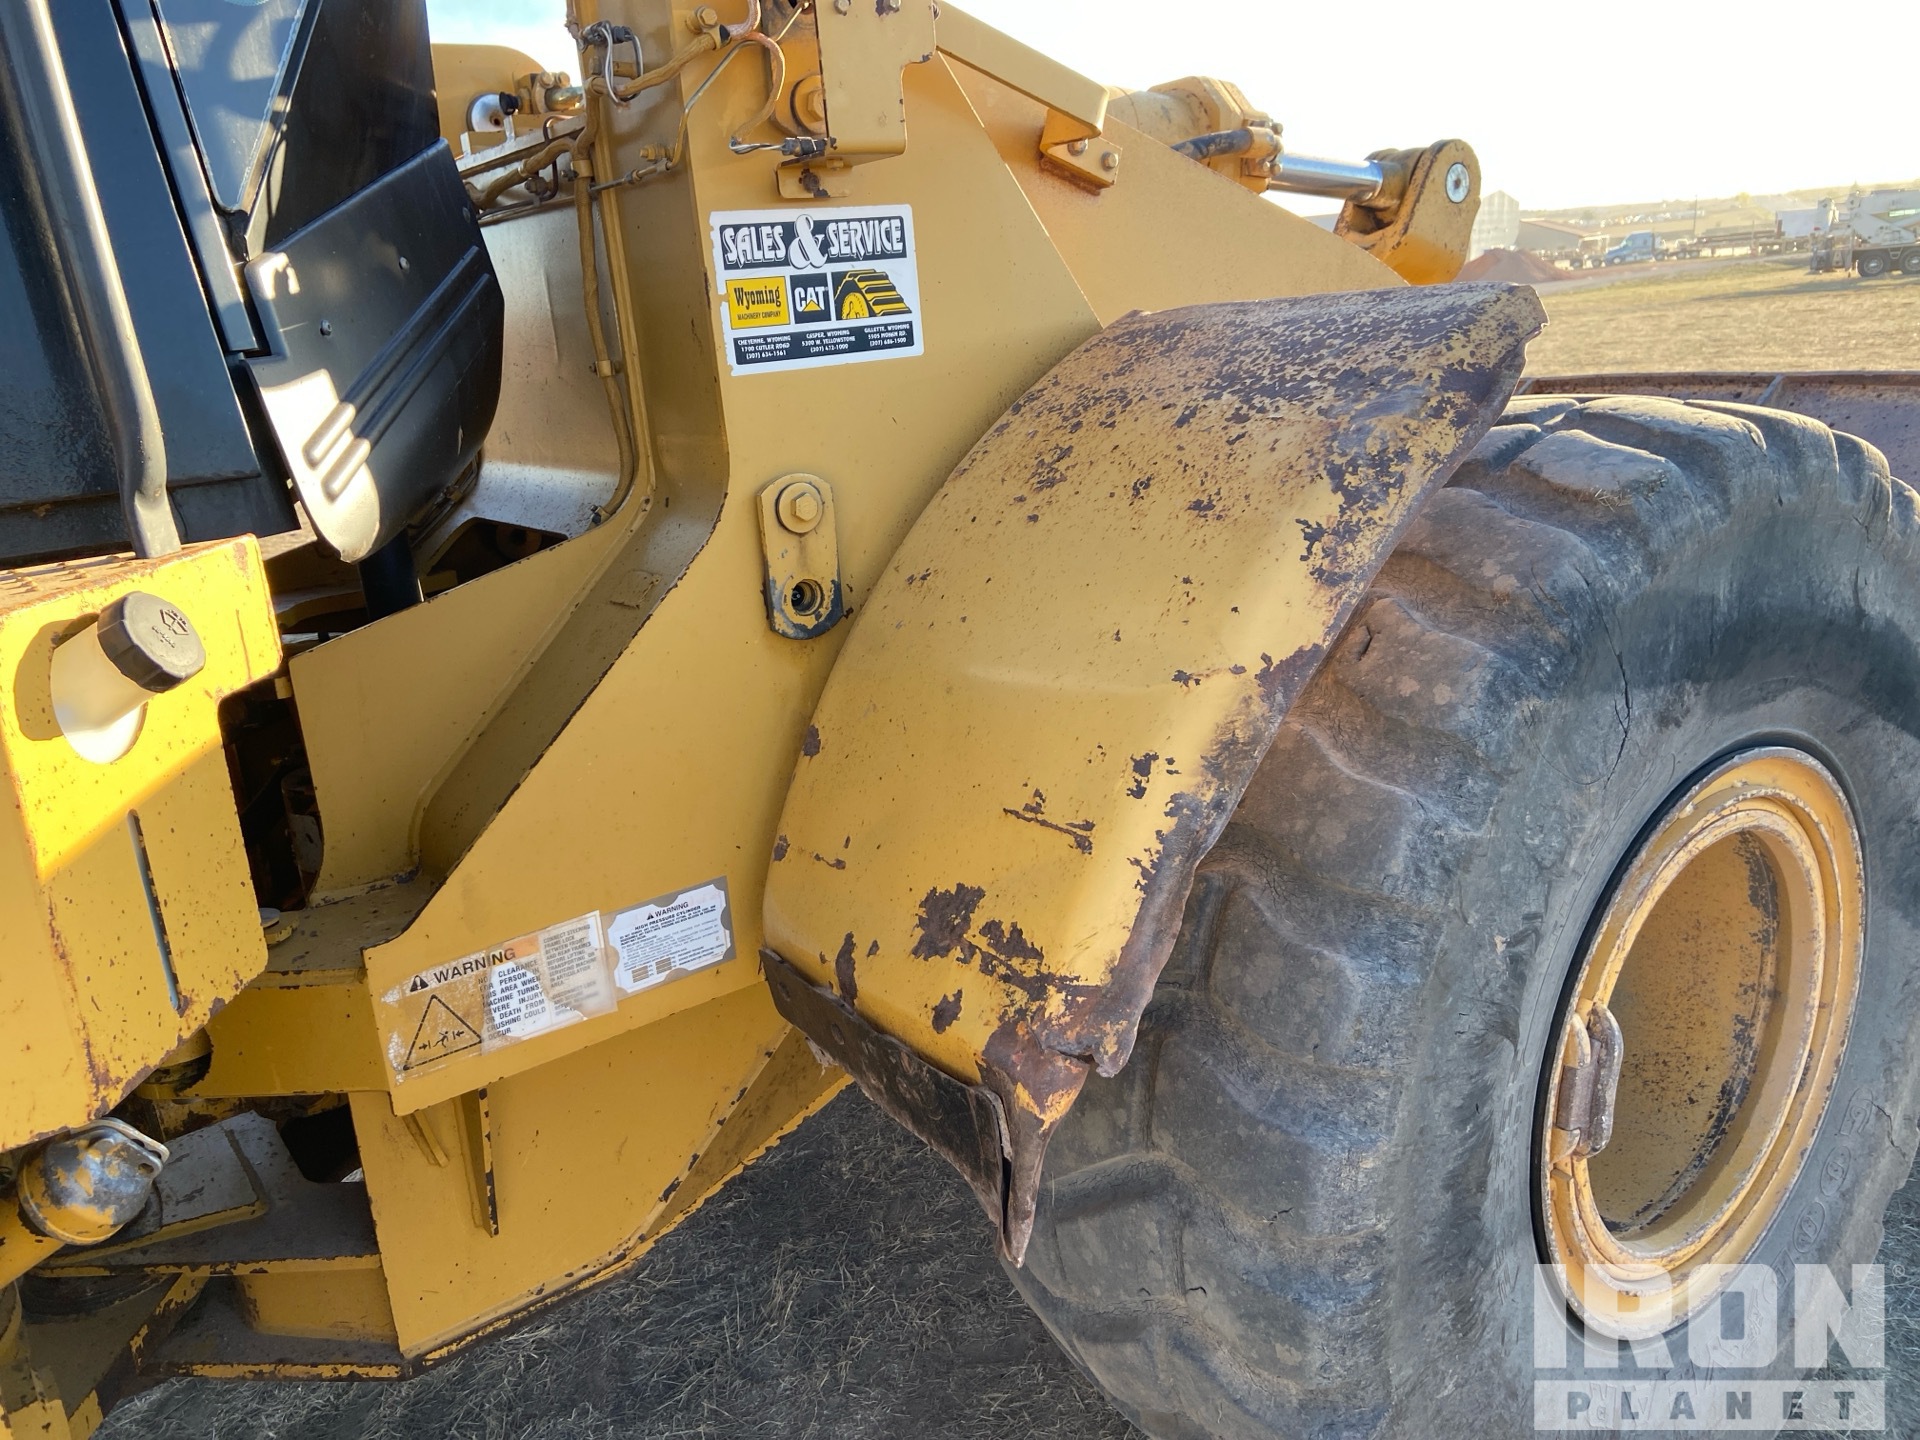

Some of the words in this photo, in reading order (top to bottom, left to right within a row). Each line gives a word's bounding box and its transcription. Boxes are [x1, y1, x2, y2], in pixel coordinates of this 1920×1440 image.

[723, 225, 786, 268] SALES
[788, 214, 828, 269] &
[827, 218, 903, 260] SERVICE
[734, 286, 781, 310] Wyoming
[794, 287, 824, 312] CAT
[767, 335, 791, 343] WYOMING
[823, 336, 855, 344] YELLOWSTONE
[649, 913, 675, 926] PRESSURE
[676, 906, 700, 916] CYLINDER
[655, 902, 688, 917] WARNING
[562, 935, 574, 943] LOCK
[499, 960, 538, 977] CLEARANCE
[500, 972, 527, 986] PERSON
[501, 982, 517, 994] AREA
[522, 975, 540, 986] WHEN
[518, 985, 539, 996] TURNS
[519, 992, 544, 1004] INJURY
[500, 1007, 521, 1020] DEATH
[526, 999, 544, 1010] FROM
[487, 1015, 521, 1032] CRUSHING
[524, 1007, 546, 1018] COULD
[488, 1027, 511, 1040] OCCUR
